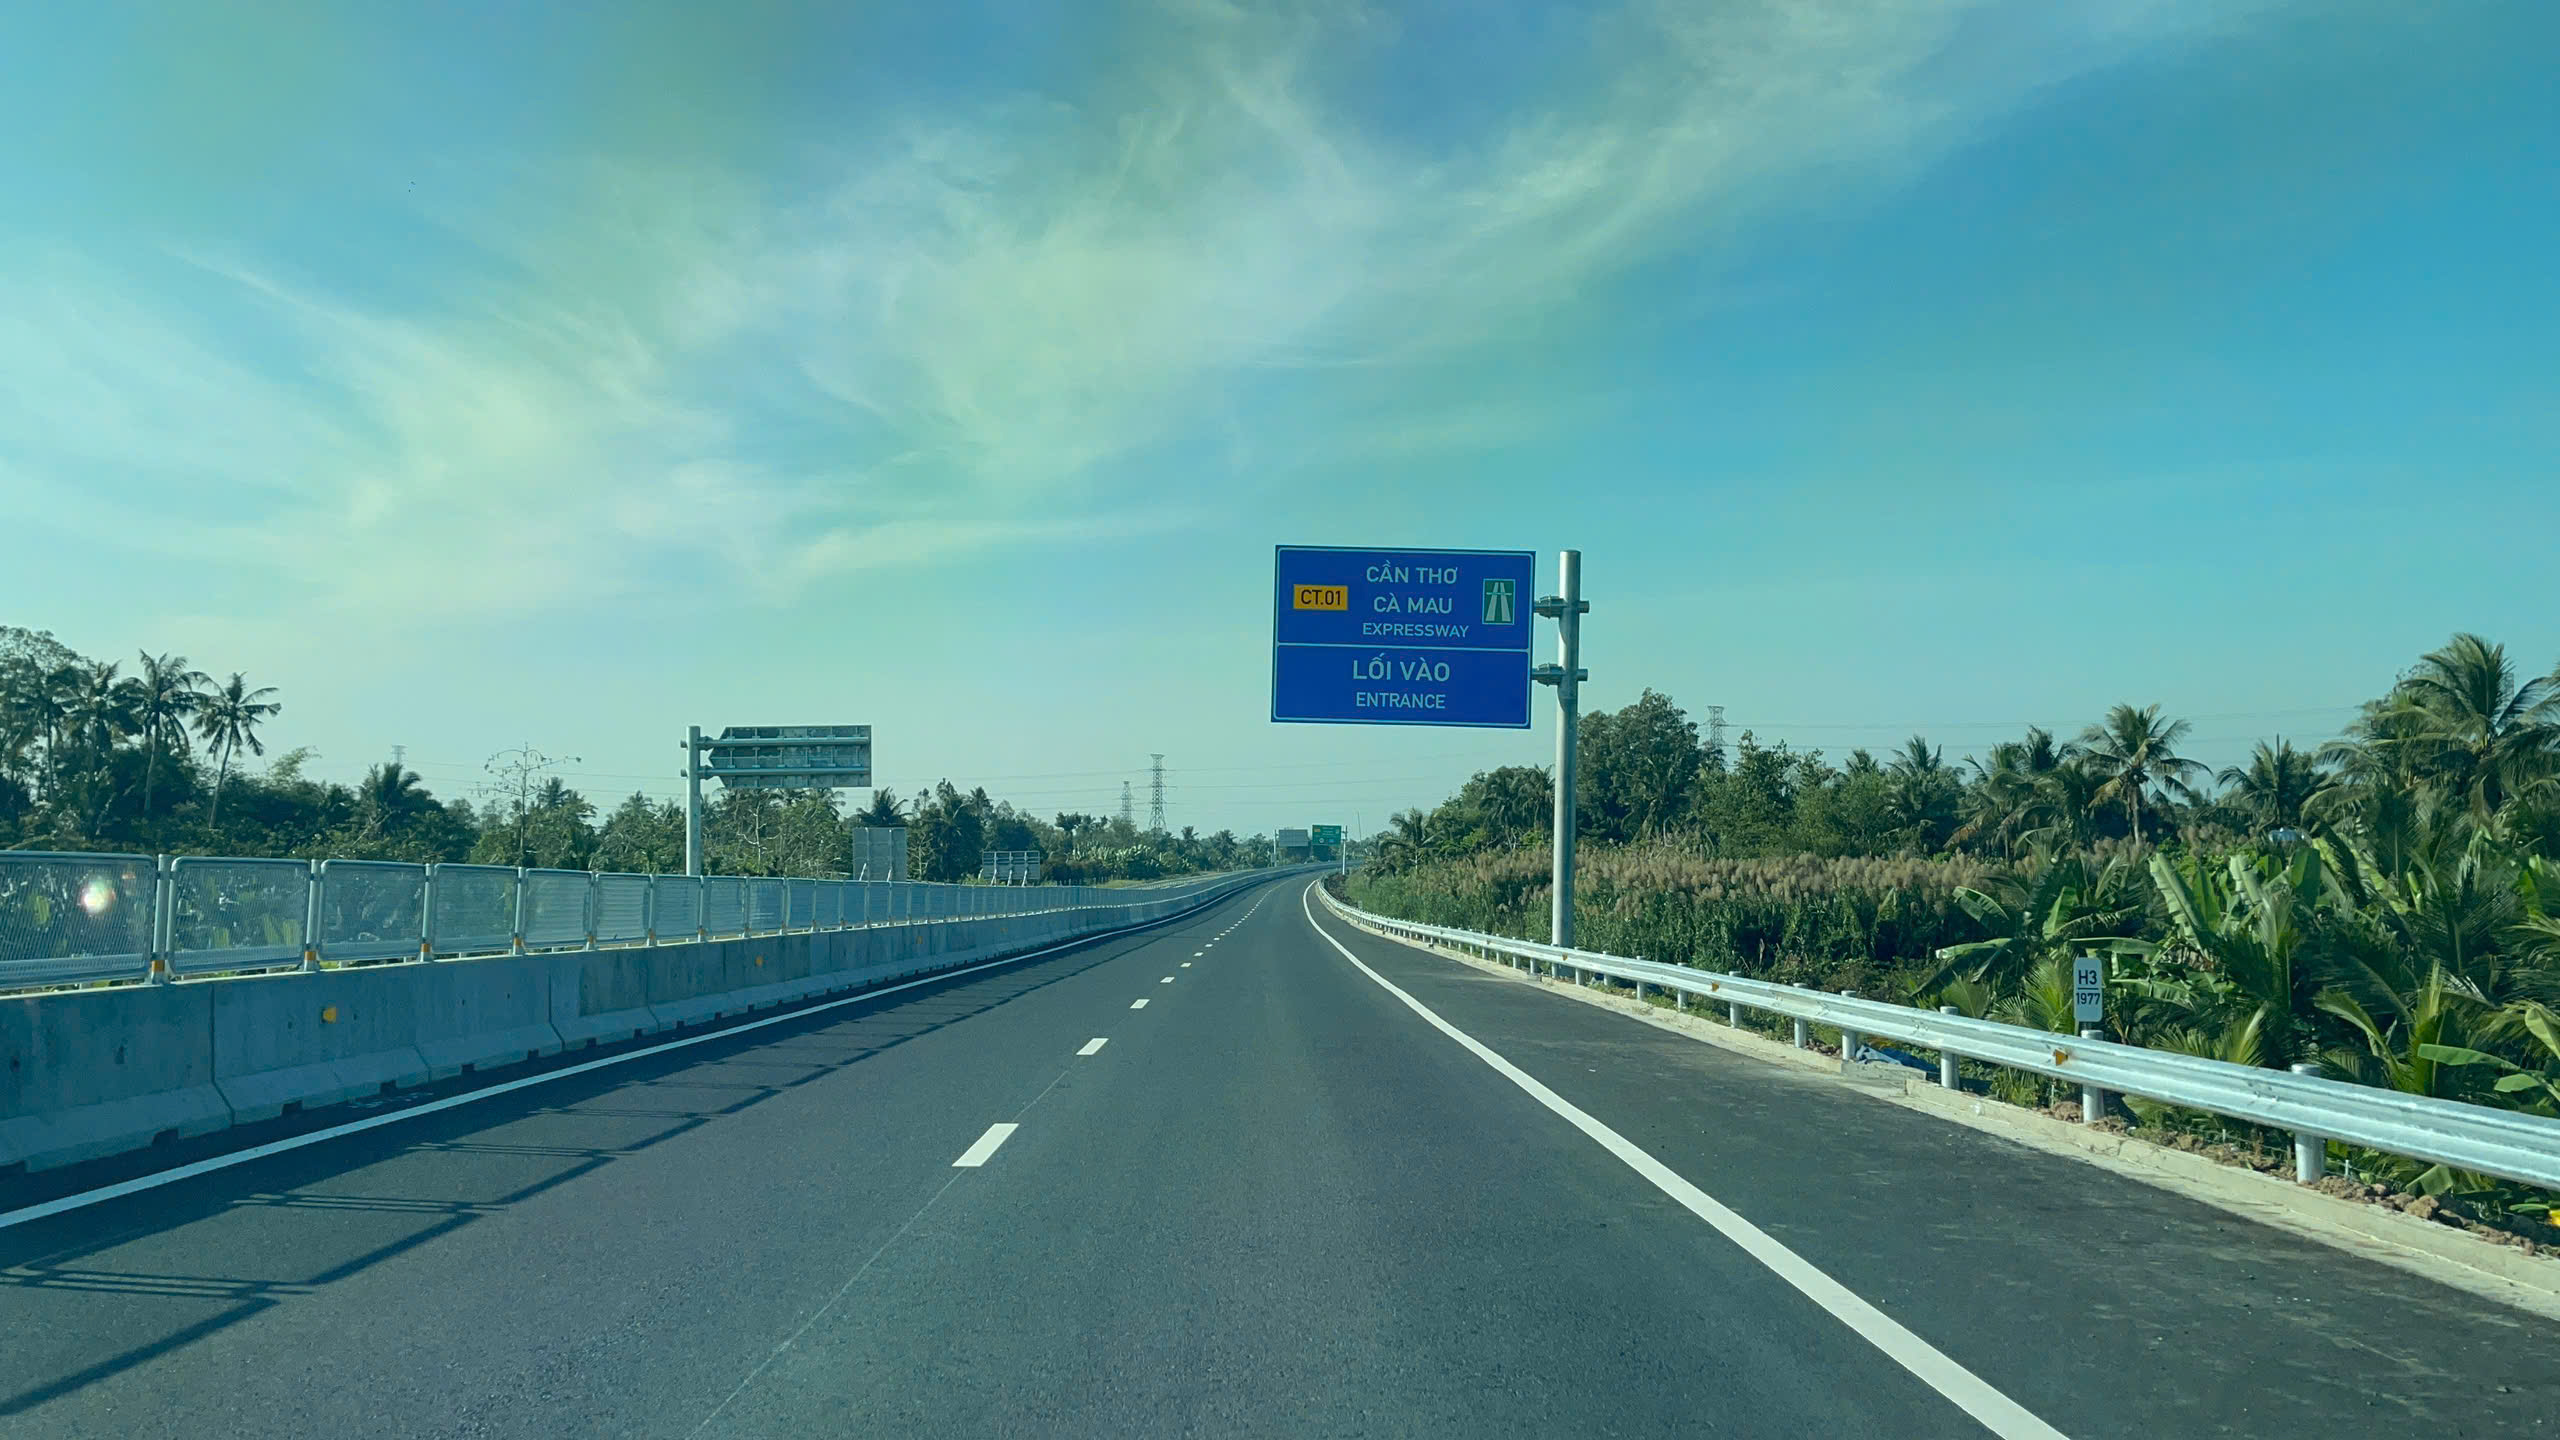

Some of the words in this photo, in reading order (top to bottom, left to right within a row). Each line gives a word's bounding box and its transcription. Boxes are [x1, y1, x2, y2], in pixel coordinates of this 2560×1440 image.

[1366, 560, 1409, 584] CẦN
[1416, 566, 1458, 585] THƠ
[1301, 589, 1342, 606] CT.01
[1373, 593, 1400, 613] CÀ
[1407, 597, 1453, 614] MAU
[1362, 623, 1469, 638] EXPRESSWAY
[1353, 653, 1392, 681] LỐI
[1400, 657, 1450, 682] VÀO
[1356, 692, 1446, 709] ENTRANCE
[2078, 970, 2097, 985] H3
[2076, 993, 2100, 1004] 1977
